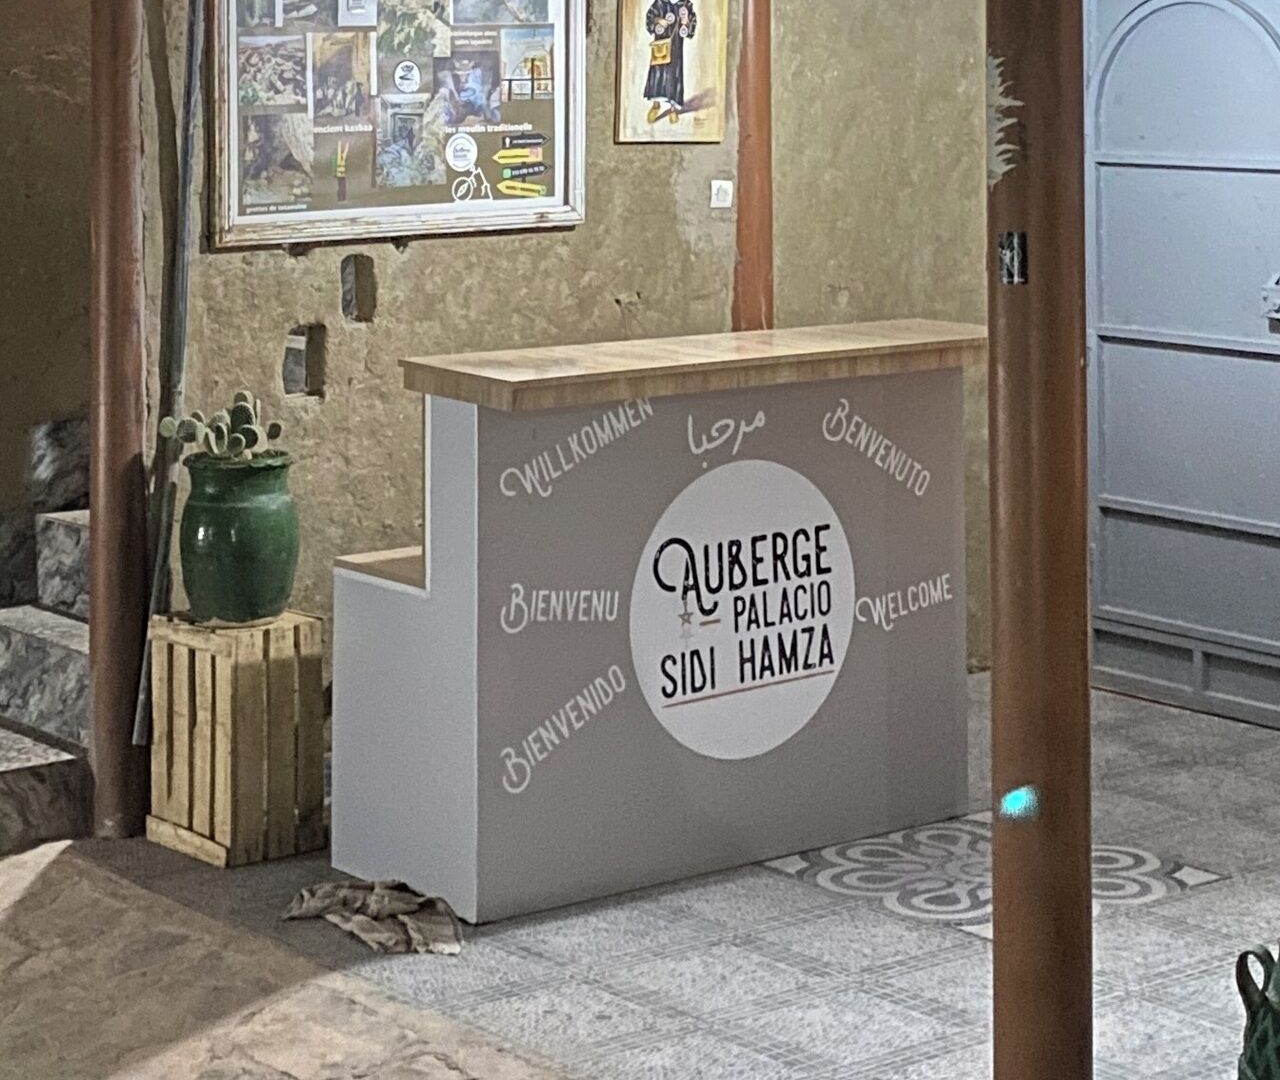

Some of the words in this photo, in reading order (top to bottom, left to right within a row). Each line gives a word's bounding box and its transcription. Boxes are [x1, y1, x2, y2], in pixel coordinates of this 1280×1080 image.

[500, 397, 654, 498] WILLKOMMEN
[687, 410, 766, 469] مرحبا
[823, 398, 931, 496] BENVENUTO
[500, 583, 619, 634] BIENVENU
[653, 523, 833, 617] AUBERGE
[733, 580, 832, 634] PALACIO
[855, 574, 953, 632] WELCOME
[660, 646, 716, 699] SIDI
[738, 622, 835, 684] HAMZA
[500, 664, 627, 794] BIENVENIDO
